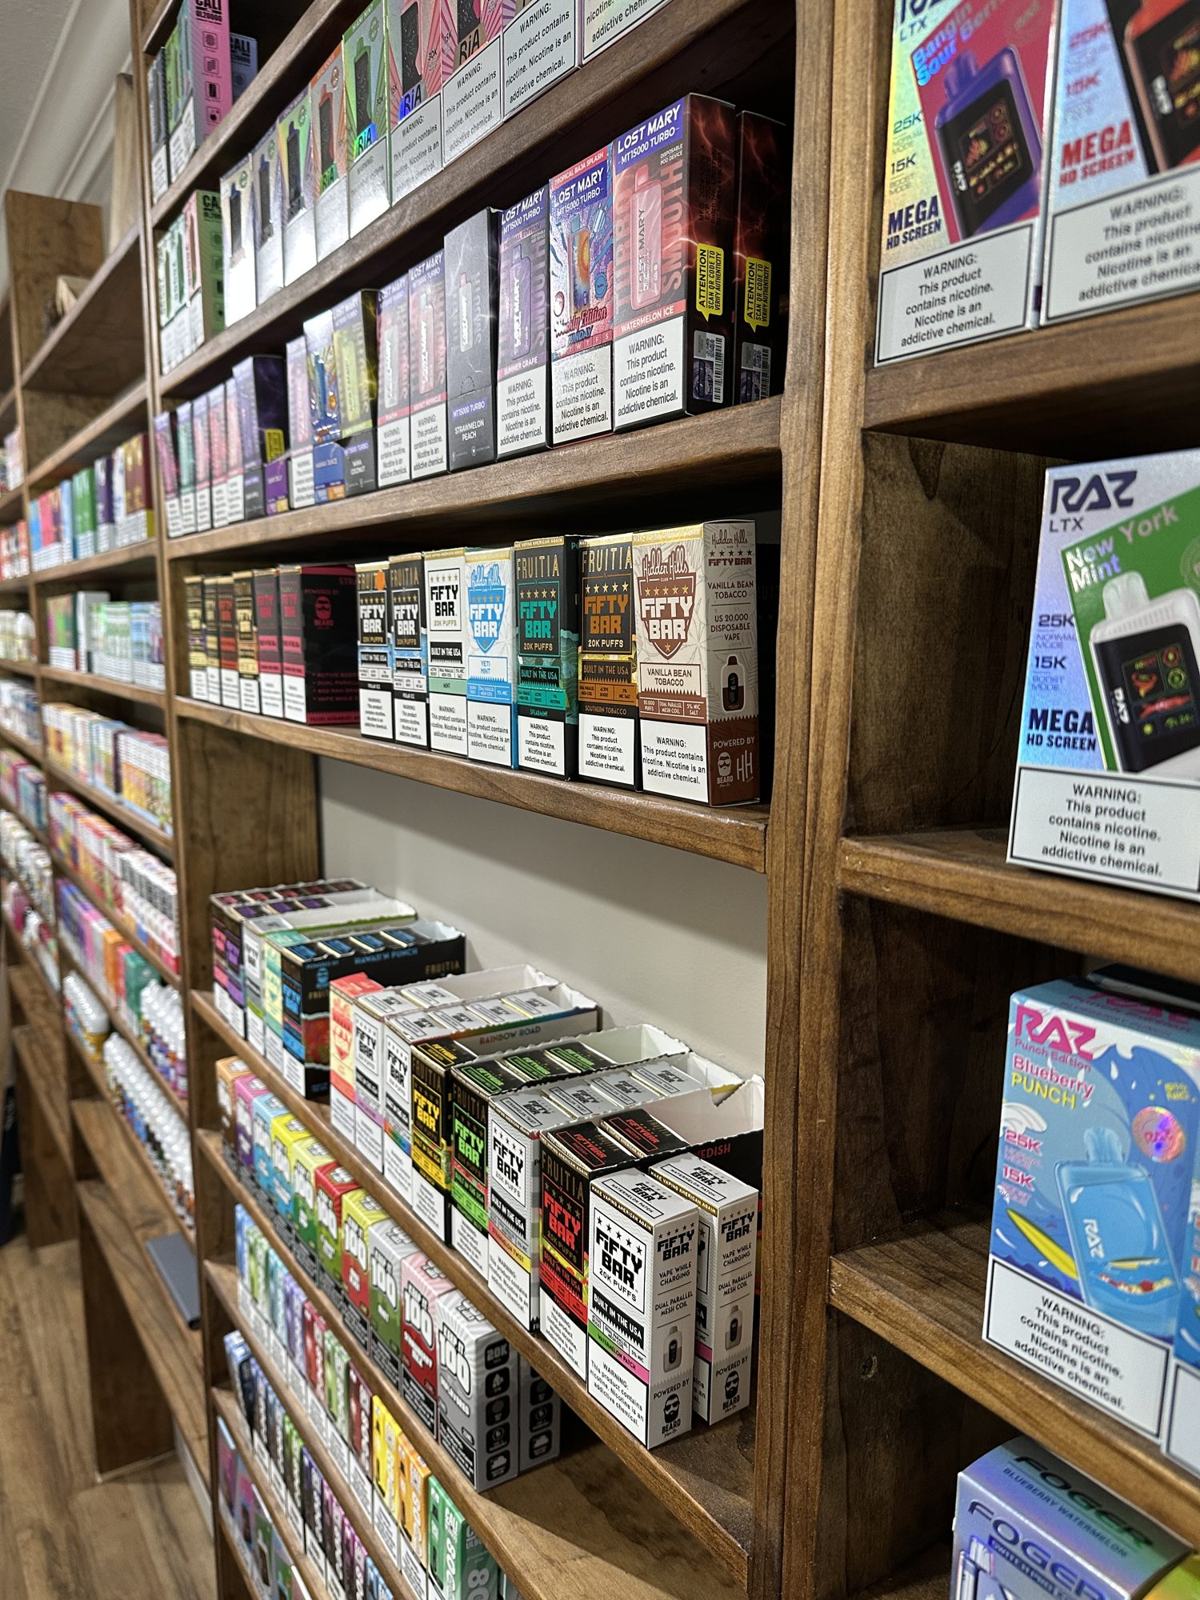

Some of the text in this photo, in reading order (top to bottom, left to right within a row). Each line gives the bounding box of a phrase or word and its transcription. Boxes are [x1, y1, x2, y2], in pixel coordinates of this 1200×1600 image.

[519, 2, 552, 34] WARNING:
[592, 12, 624, 43] addictive
[518, 10, 570, 58] product contains
[505, 43, 554, 88] nicotine. Nicotine
[509, 55, 566, 104] addictive chemical.
[617, 104, 681, 154] LOST MARY
[893, 111, 923, 134] 25K
[649, 126, 676, 150] TURBO
[1061, 118, 1132, 169] MEGA
[891, 154, 917, 175] 15K
[1081, 149, 1136, 180] SCREEN
[553, 185, 576, 208] LOST
[577, 167, 604, 193] MARY
[501, 188, 545, 225] LOST MARY
[887, 195, 940, 236] MEGA
[1109, 186, 1185, 220] WARNING:
[886, 219, 942, 250] HD SCREEN
[1103, 203, 1192, 241] This product
[1085, 237, 1143, 265] contains
[698, 248, 707, 308] ATTENTION
[923, 254, 979, 279] WARNING:
[1097, 255, 1152, 279] Nicotine
[747, 262, 756, 319] ATTENTION
[918, 268, 983, 297] This product
[1078, 276, 1138, 301] addictive
[905, 283, 994, 315] contains nicotine.
[620, 305, 674, 332] WATERMELON ICE
[914, 301, 983, 328] Nicotine is an
[901, 313, 996, 347] addictive chemical.
[628, 334, 665, 355] WARNING:
[626, 348, 668, 371] This product
[619, 361, 676, 388] contains nicotine.
[625, 380, 651, 399] Nicotine
[561, 405, 584, 420] Nicotine
[617, 391, 679, 417] addictive chemical.
[554, 410, 609, 434] addictive chemical.
[1050, 470, 1138, 515] RAZ
[1049, 517, 1085, 533] LTX
[1119, 504, 1179, 544] York
[516, 554, 560, 580] FRUITIA
[581, 545, 633, 573] FRUITIA
[642, 545, 690, 582] Hidden Hills
[735, 557, 753, 565] BAR
[707, 580, 754, 590] VANILLA BEAN
[1070, 554, 1121, 593] Mint
[715, 591, 748, 600] TOBACCO
[434, 601, 456, 617] BAR
[1038, 613, 1075, 628] 25K
[363, 619, 382, 634] BAR
[397, 620, 416, 636] BAR
[474, 621, 498, 638] BAR
[525, 620, 551, 639] BAR
[589, 615, 622, 635] BAR
[649, 618, 687, 640] BAR
[710, 623, 751, 632] DISPOSABLE
[724, 632, 740, 640] VAPE
[587, 639, 624, 648] 20K PUFFS
[647, 668, 692, 678] VANILLA BEAN
[1034, 656, 1067, 669] 15K
[655, 677, 684, 687] TOBACCO
[1028, 708, 1095, 734] MEGA
[656, 736, 687, 748] WARNING:
[713, 739, 745, 749] POWERED
[1026, 734, 1097, 751] HD SCREEN
[642, 757, 690, 771] nicotine. Nicotine
[655, 748, 704, 762] product contains
[647, 768, 701, 785] addictive chemical.
[1073, 783, 1142, 804] WARNING:
[1066, 800, 1146, 822] This product
[1049, 815, 1161, 841] contains nicotine.
[1059, 832, 1145, 856] Nicotine is an
[1042, 845, 1163, 876] addictive chemical.
[1014, 1005, 1097, 1061] RAZ
[1015, 1038, 1092, 1072] Punch Edition
[1012, 1055, 1094, 1100] Blueberry
[1011, 1071, 1077, 1110] PUNCH
[416, 1105, 436, 1132] BAR
[459, 1137, 480, 1168] BAR
[1004, 1130, 1041, 1153] 25K
[497, 1155, 519, 1186] BAR
[1003, 1165, 1034, 1189] 15K
[549, 1215, 576, 1250] BAR
[726, 1224, 750, 1243] BAR
[662, 1242, 690, 1261] BAR
[723, 1251, 751, 1267] CHARGING
[601, 1249, 635, 1291] BAR
[658, 1261, 692, 1279] VAPE WHILE
[660, 1270, 691, 1286] CHARGING
[613, 1279, 637, 1302] PUFFS
[669, 1292, 694, 1305] PARALLEL
[1041, 1296, 1106, 1339] WARNING:
[1035, 1307, 1109, 1356] This product
[1020, 1315, 1124, 1379] contains nicotine.
[1031, 1333, 1109, 1385] Nicotine is an
[716, 1361, 740, 1377] POWERED
[1014, 1340, 1125, 1411] addictive chemical.
[653, 1382, 681, 1400] POWERED
[661, 1420, 681, 1435] BEARD
[1003, 1466, 1128, 1558] BLUEBERRY WATERMELON
[1014, 1455, 1154, 1548] FOGER
